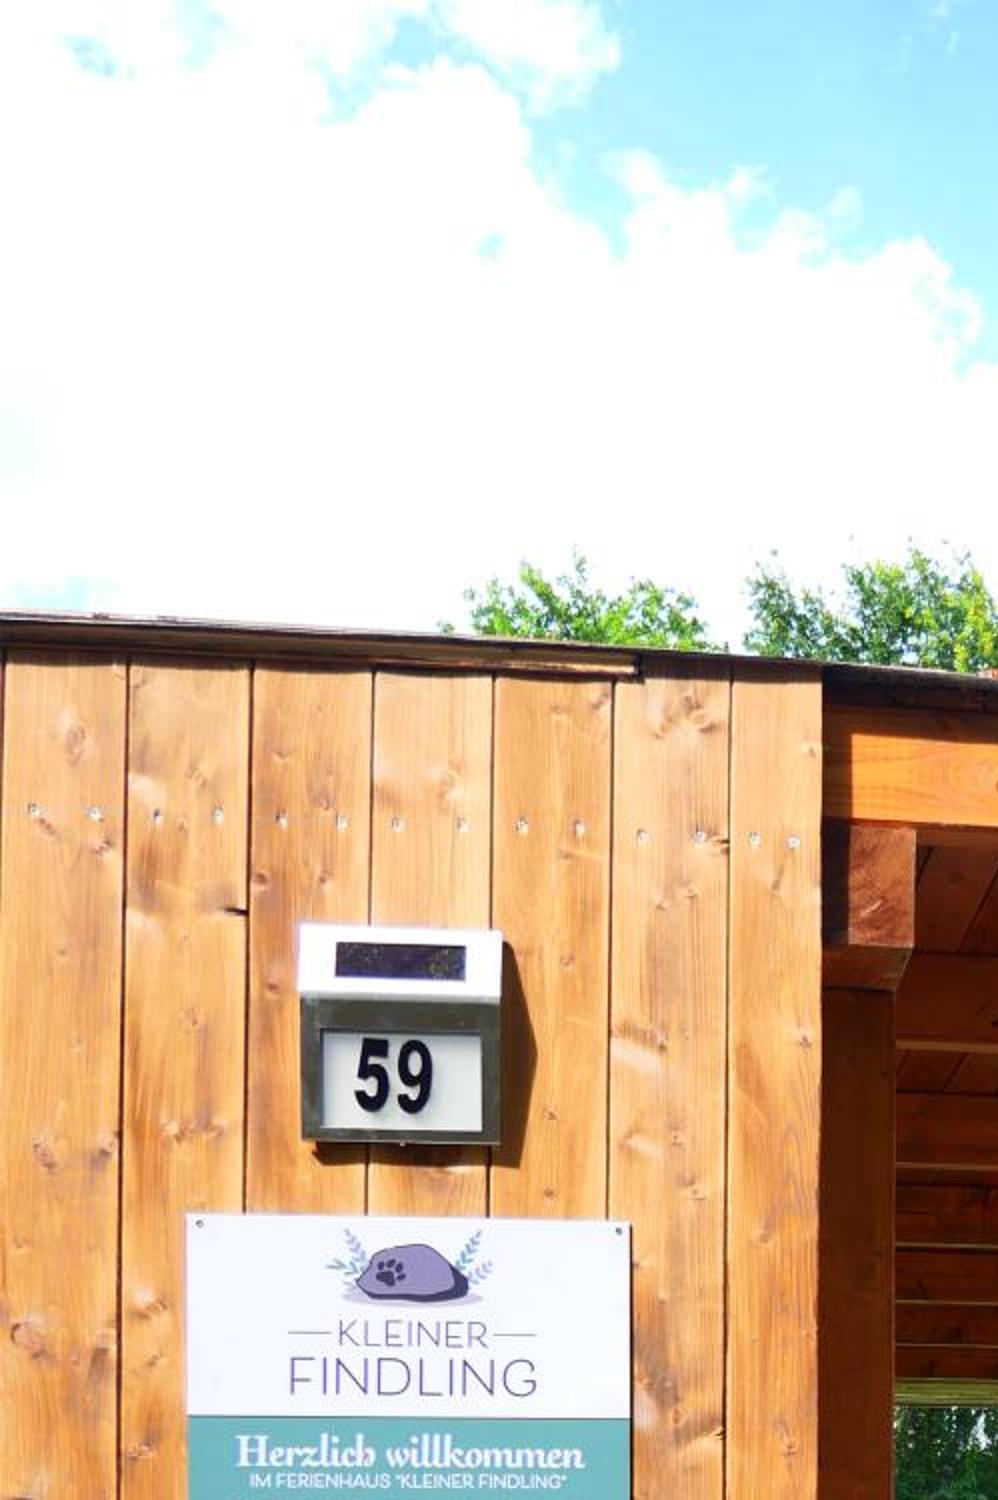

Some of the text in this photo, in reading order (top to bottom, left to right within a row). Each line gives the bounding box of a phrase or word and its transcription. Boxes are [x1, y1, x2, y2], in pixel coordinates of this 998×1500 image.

[354, 1038, 432, 1114] 59
[338, 1319, 489, 1348] KLEINER
[289, 1356, 537, 1397] FINDLING
[235, 1433, 585, 1468] Herzlich willkommen
[249, 1473, 271, 1489] IM
[275, 1473, 391, 1489] FERIENHAUS
